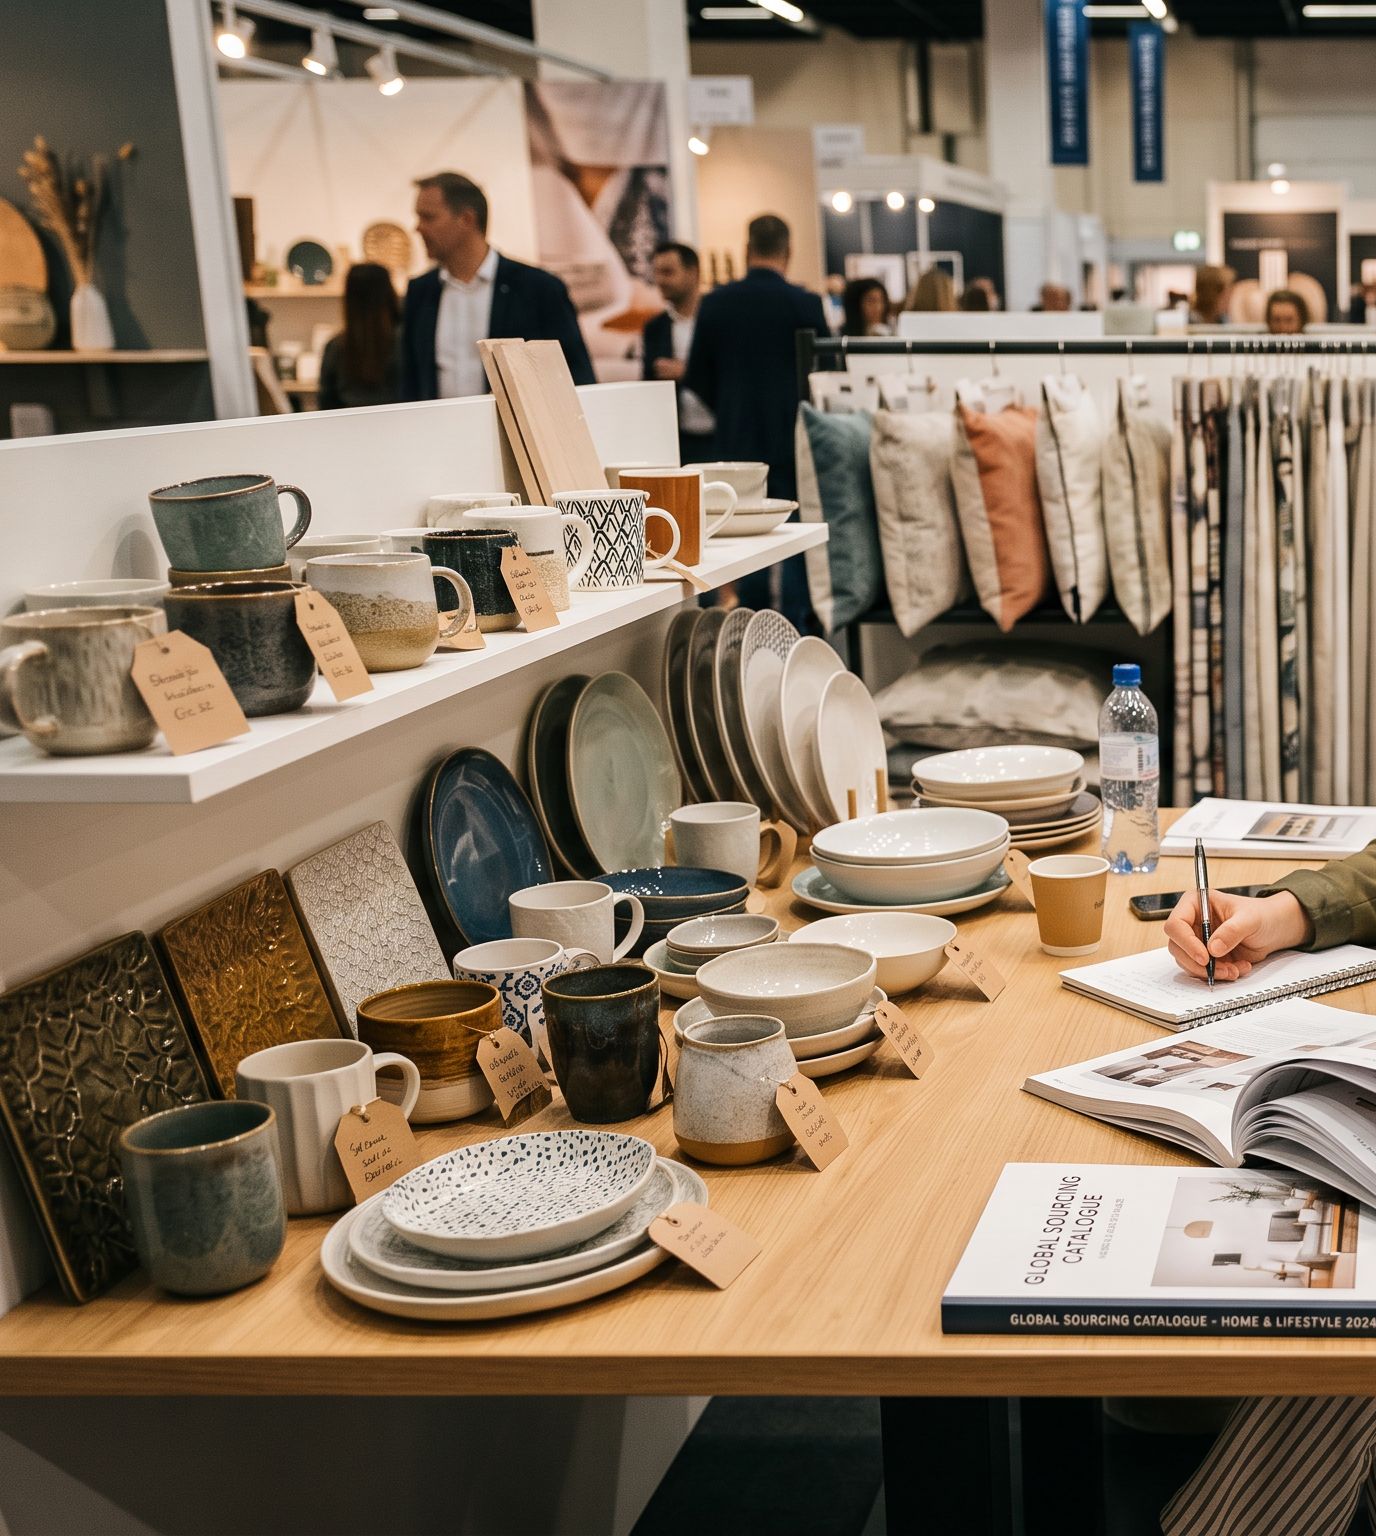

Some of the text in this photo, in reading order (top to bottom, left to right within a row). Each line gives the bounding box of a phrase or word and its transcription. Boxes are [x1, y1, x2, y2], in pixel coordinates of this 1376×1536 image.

[1024, 1175, 1081, 1285] GLOBAL SOURCING
[1062, 1194, 1103, 1264] CATALOGUE
[1010, 1313, 1059, 1326] GLOBAL
[1063, 1314, 1129, 1326] SOURCING
[1133, 1315, 1207, 1327] CATALOGUE
[1221, 1315, 1259, 1327] HOME
[1263, 1316, 1272, 1328] &
[1276, 1316, 1342, 1328] LIFESTYLE
